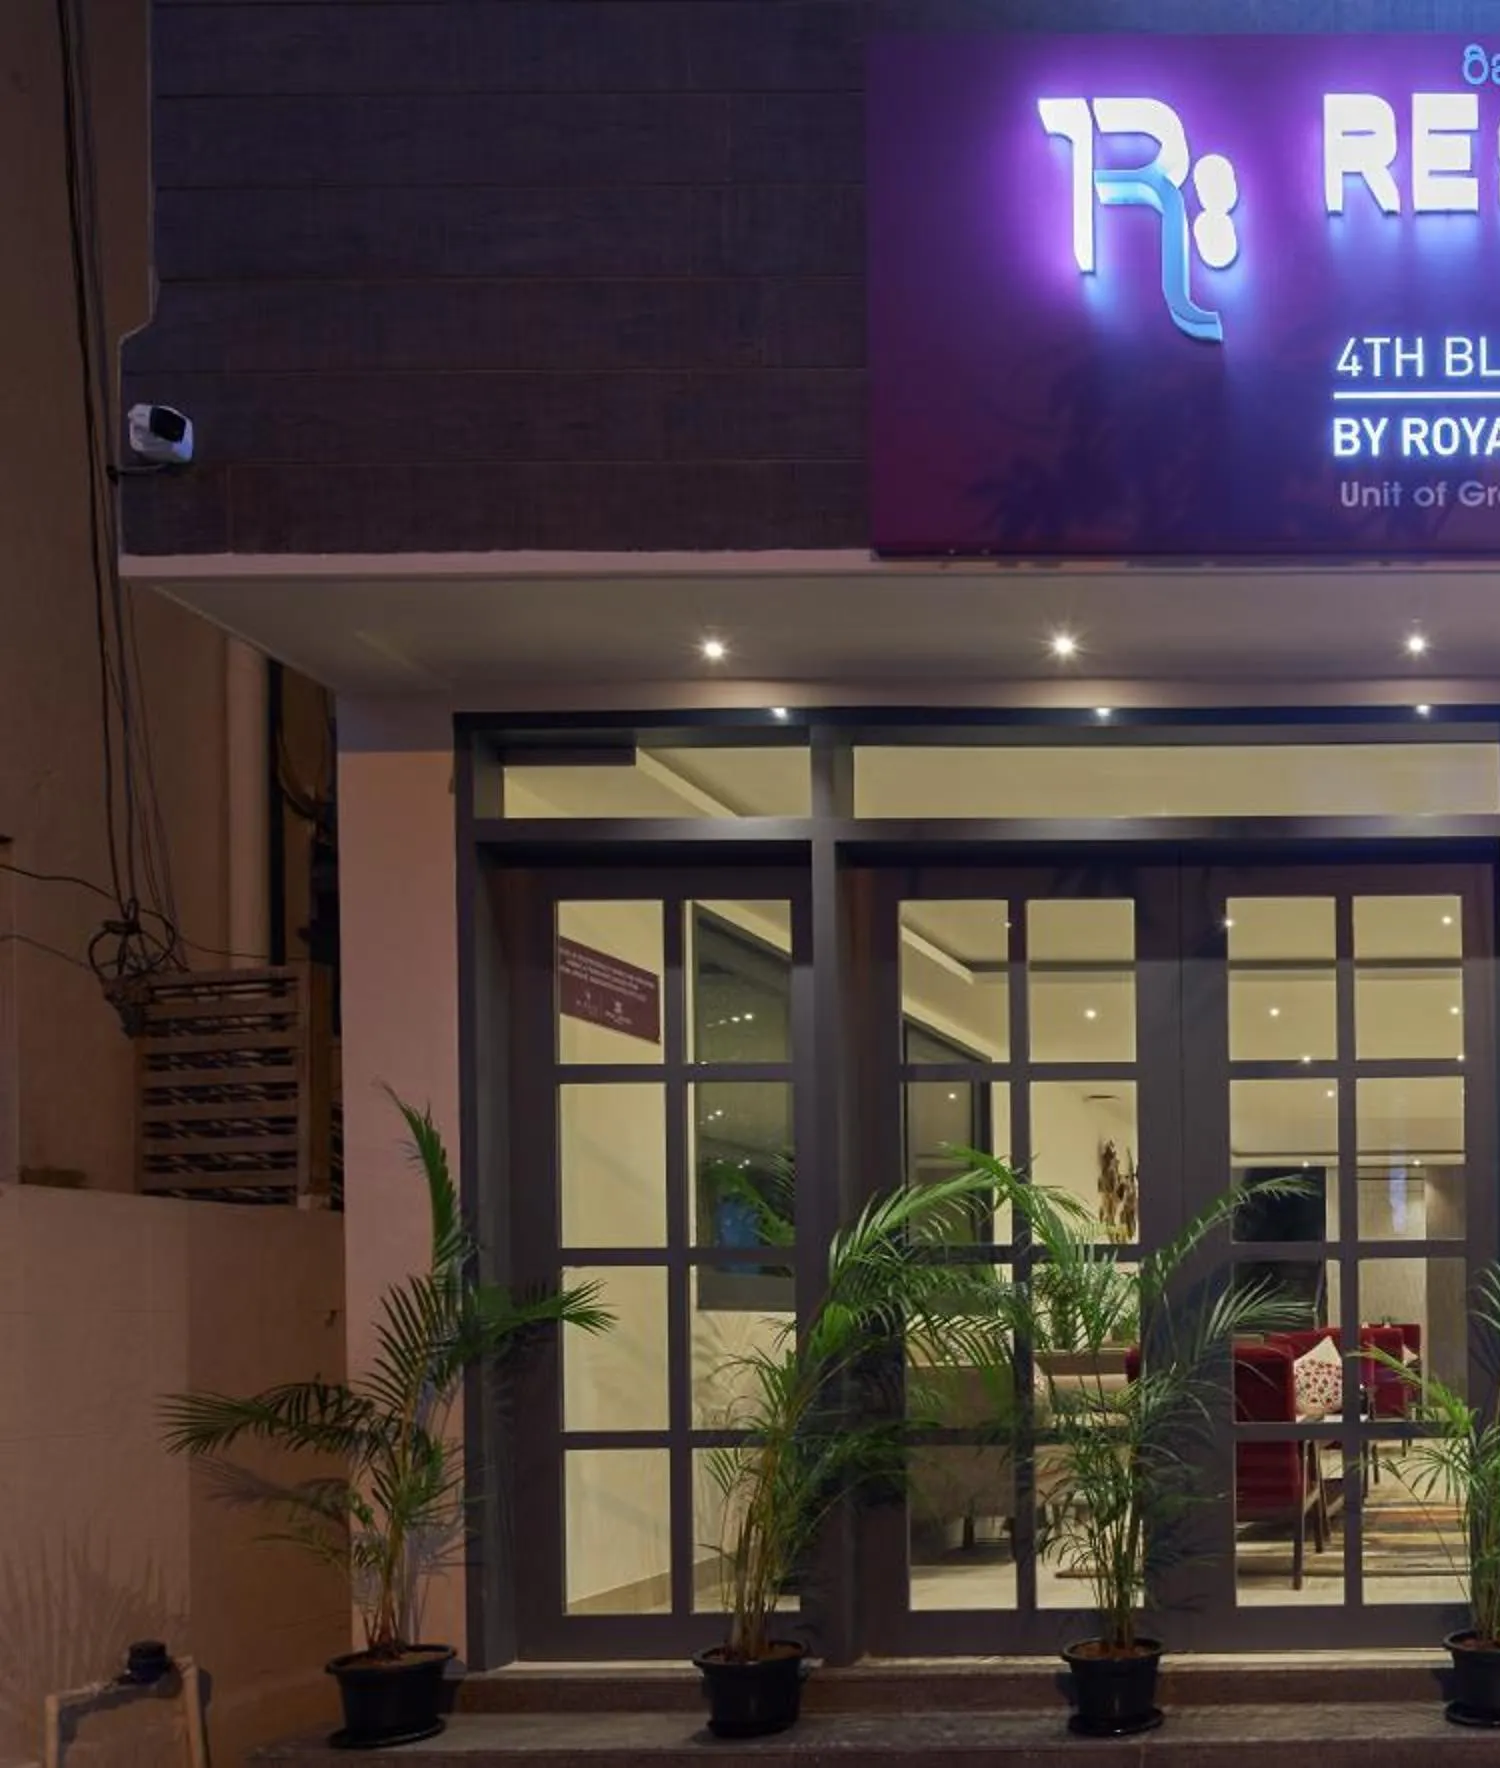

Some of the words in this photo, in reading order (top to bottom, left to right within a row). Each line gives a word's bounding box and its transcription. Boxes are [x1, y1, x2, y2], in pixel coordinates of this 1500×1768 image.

[1336, 336, 1426, 378] 4TH
[1332, 417, 1389, 457] BY
[1340, 480, 1409, 508] Unit
[1413, 480, 1447, 508] of
